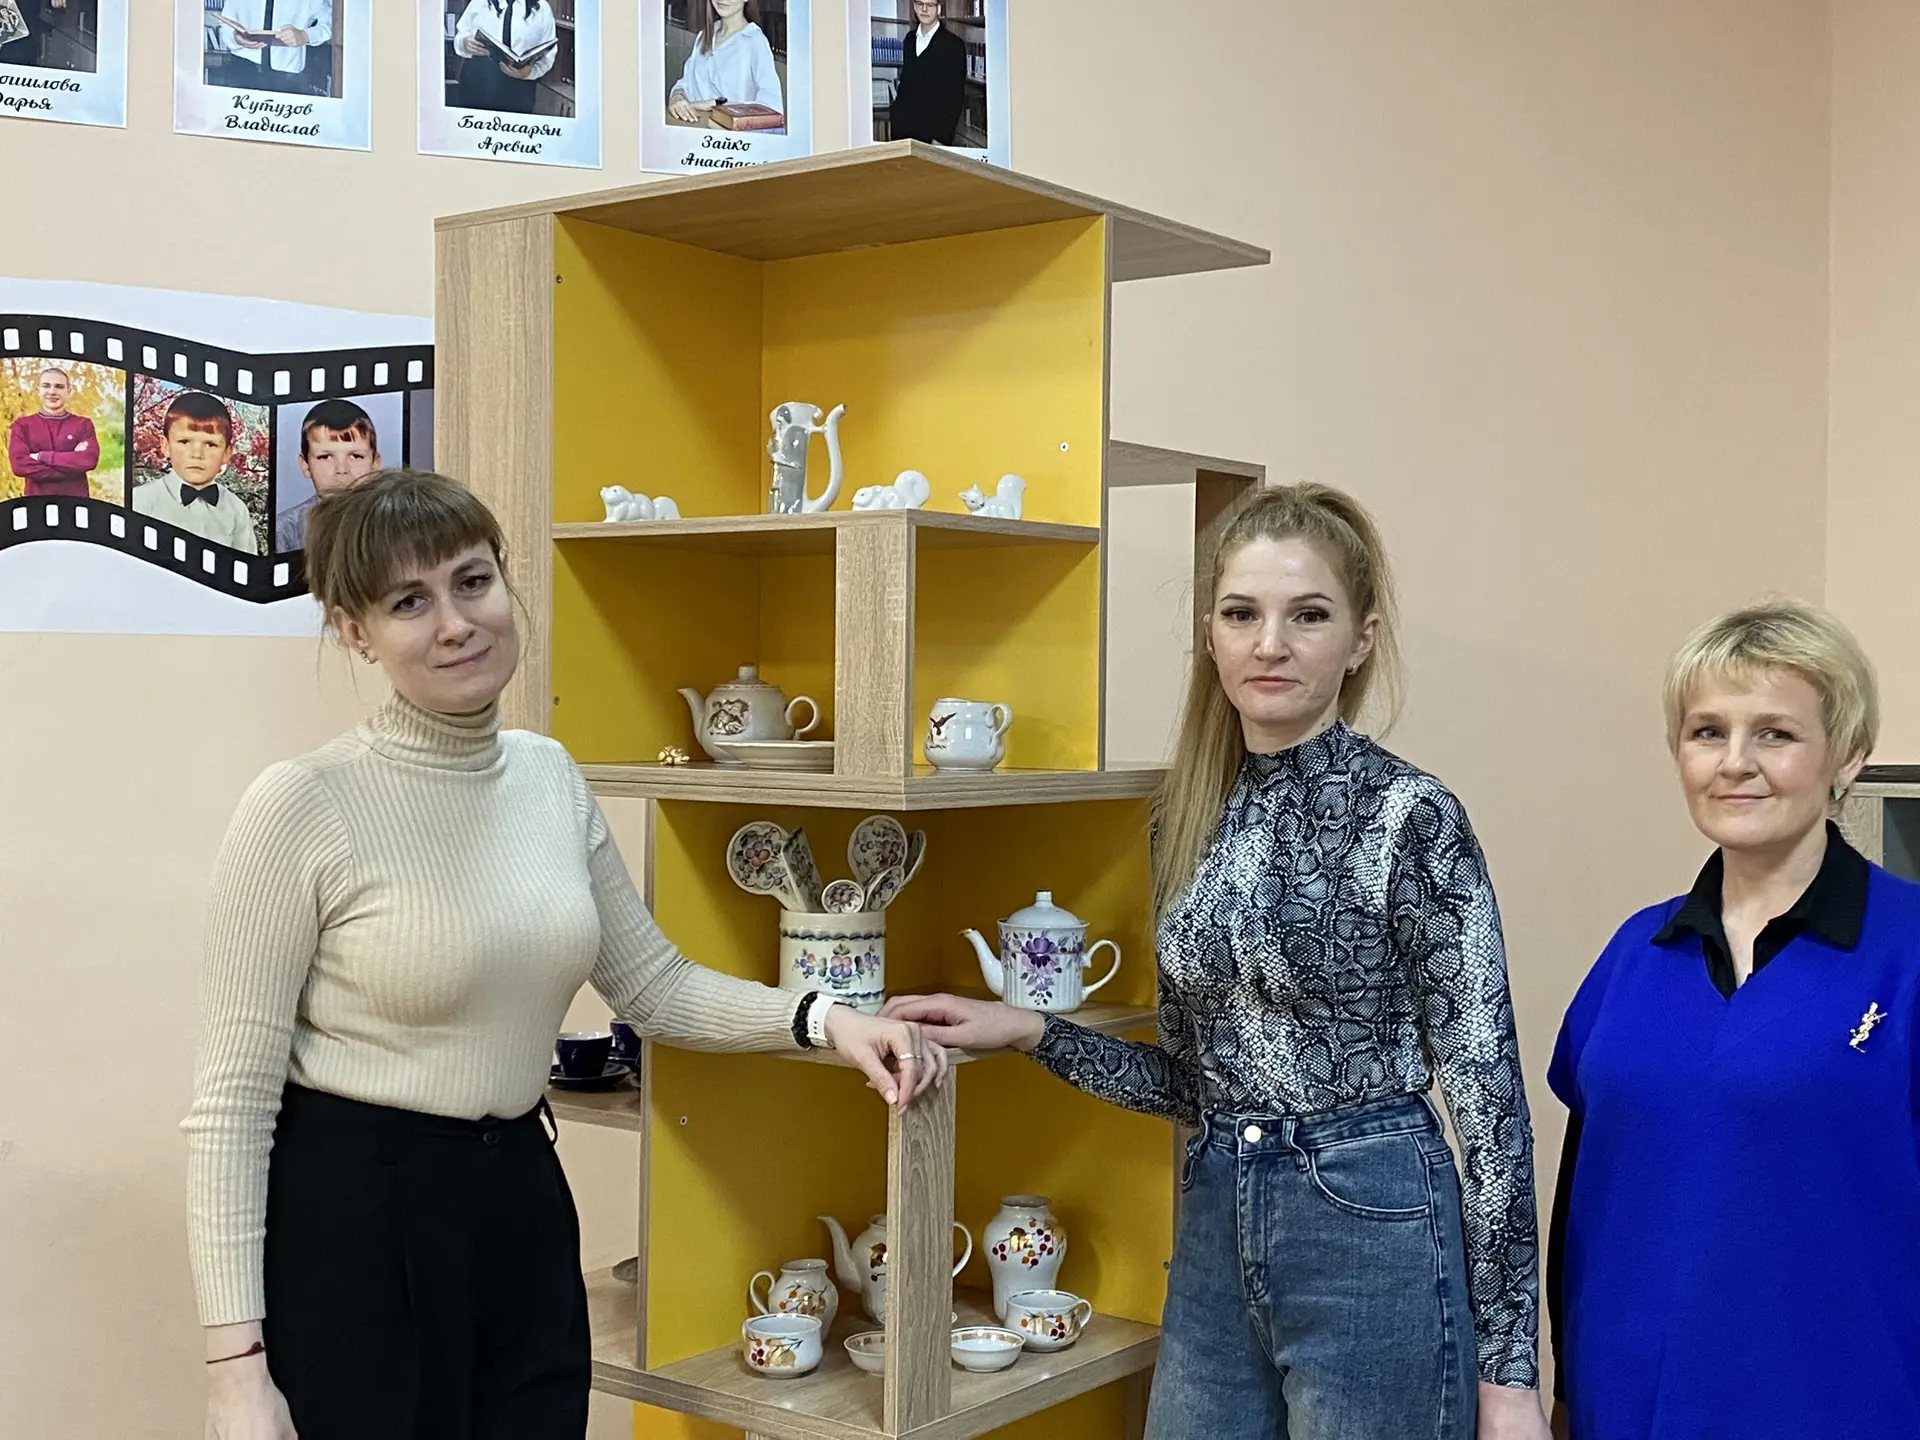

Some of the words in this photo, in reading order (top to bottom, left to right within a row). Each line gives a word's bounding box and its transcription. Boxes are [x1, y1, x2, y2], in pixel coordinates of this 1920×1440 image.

[0, 92, 53, 112] арья
[232, 95, 314, 118] Кутузов
[225, 115, 320, 136] Владислав
[457, 115, 563, 138] Багдасарян
[478, 136, 542, 155] Аревик
[701, 135, 751, 151] Зайко
